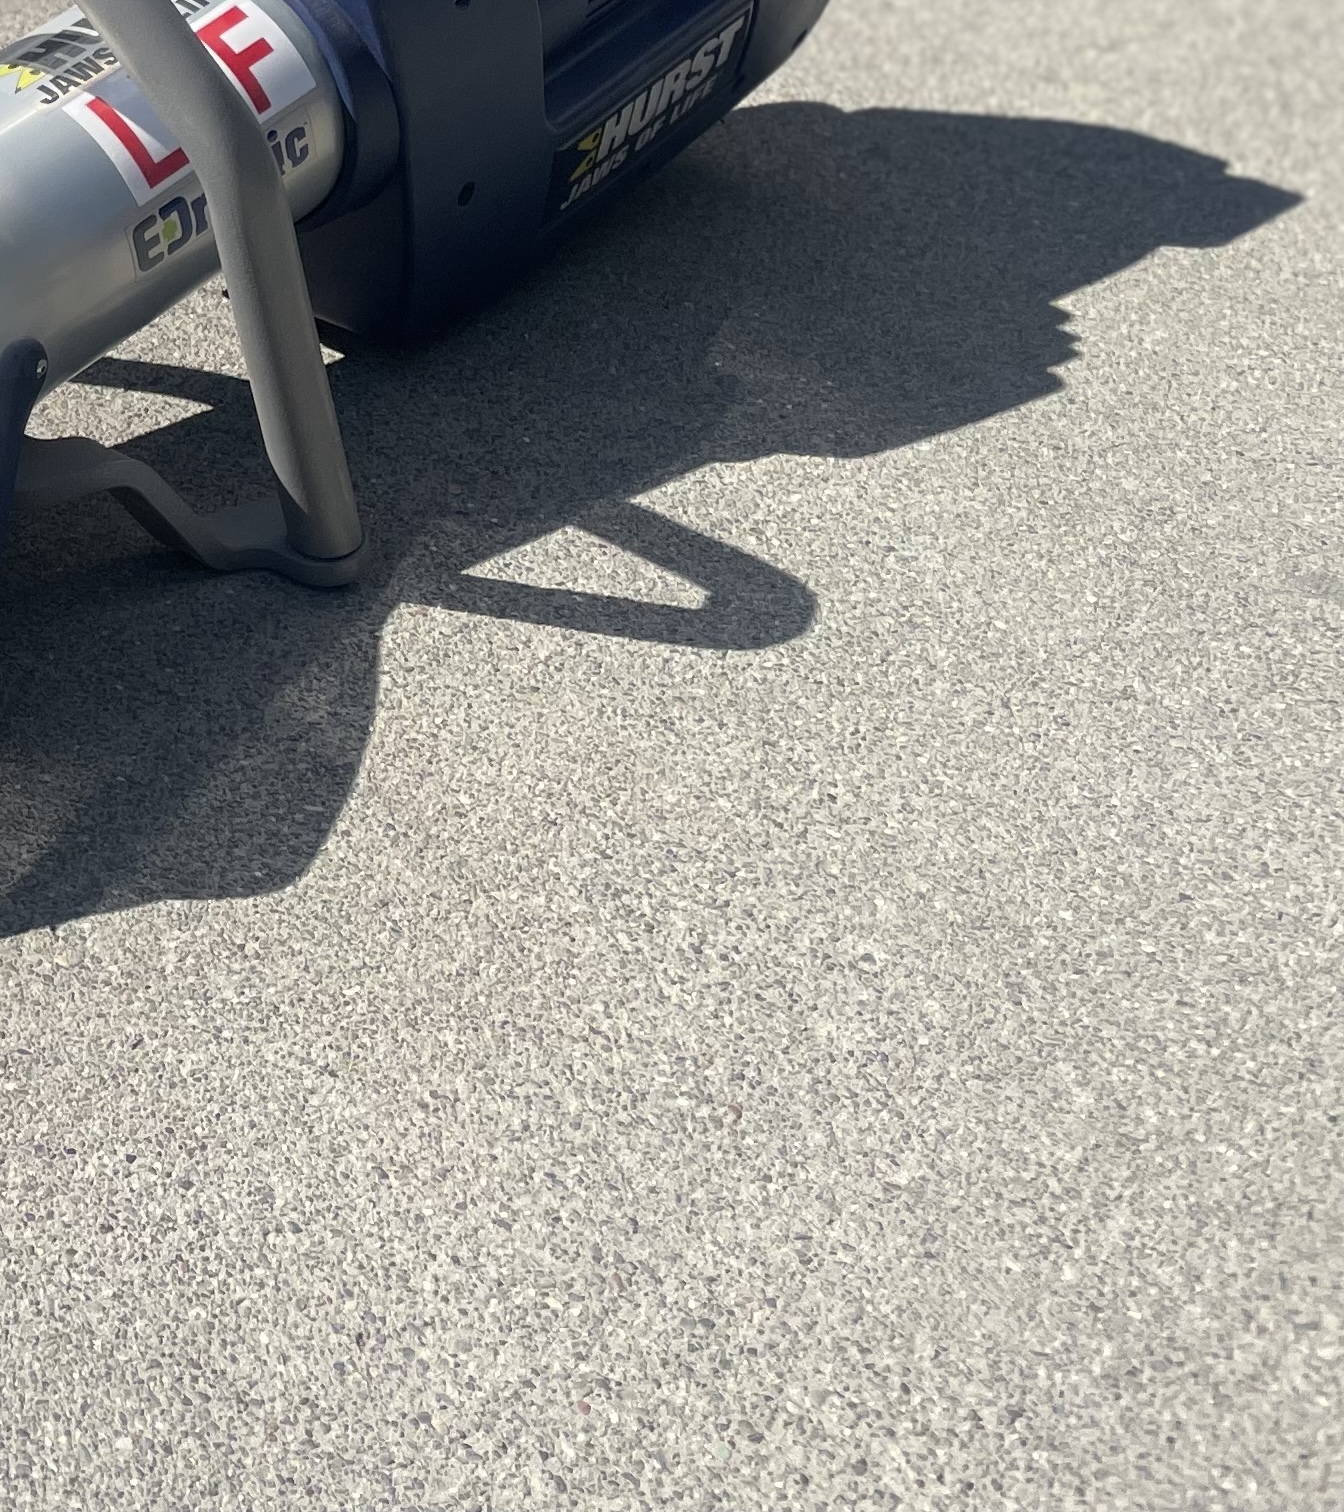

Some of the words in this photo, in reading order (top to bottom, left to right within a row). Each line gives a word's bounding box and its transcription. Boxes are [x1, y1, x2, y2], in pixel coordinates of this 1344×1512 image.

[37, 48, 118, 104] JAWS
[85, 5, 274, 189] LF
[560, 144, 630, 210] JAWS
[634, 115, 667, 152] OF
[669, 72, 719, 125] LIFE
[595, 15, 746, 163] HURST
